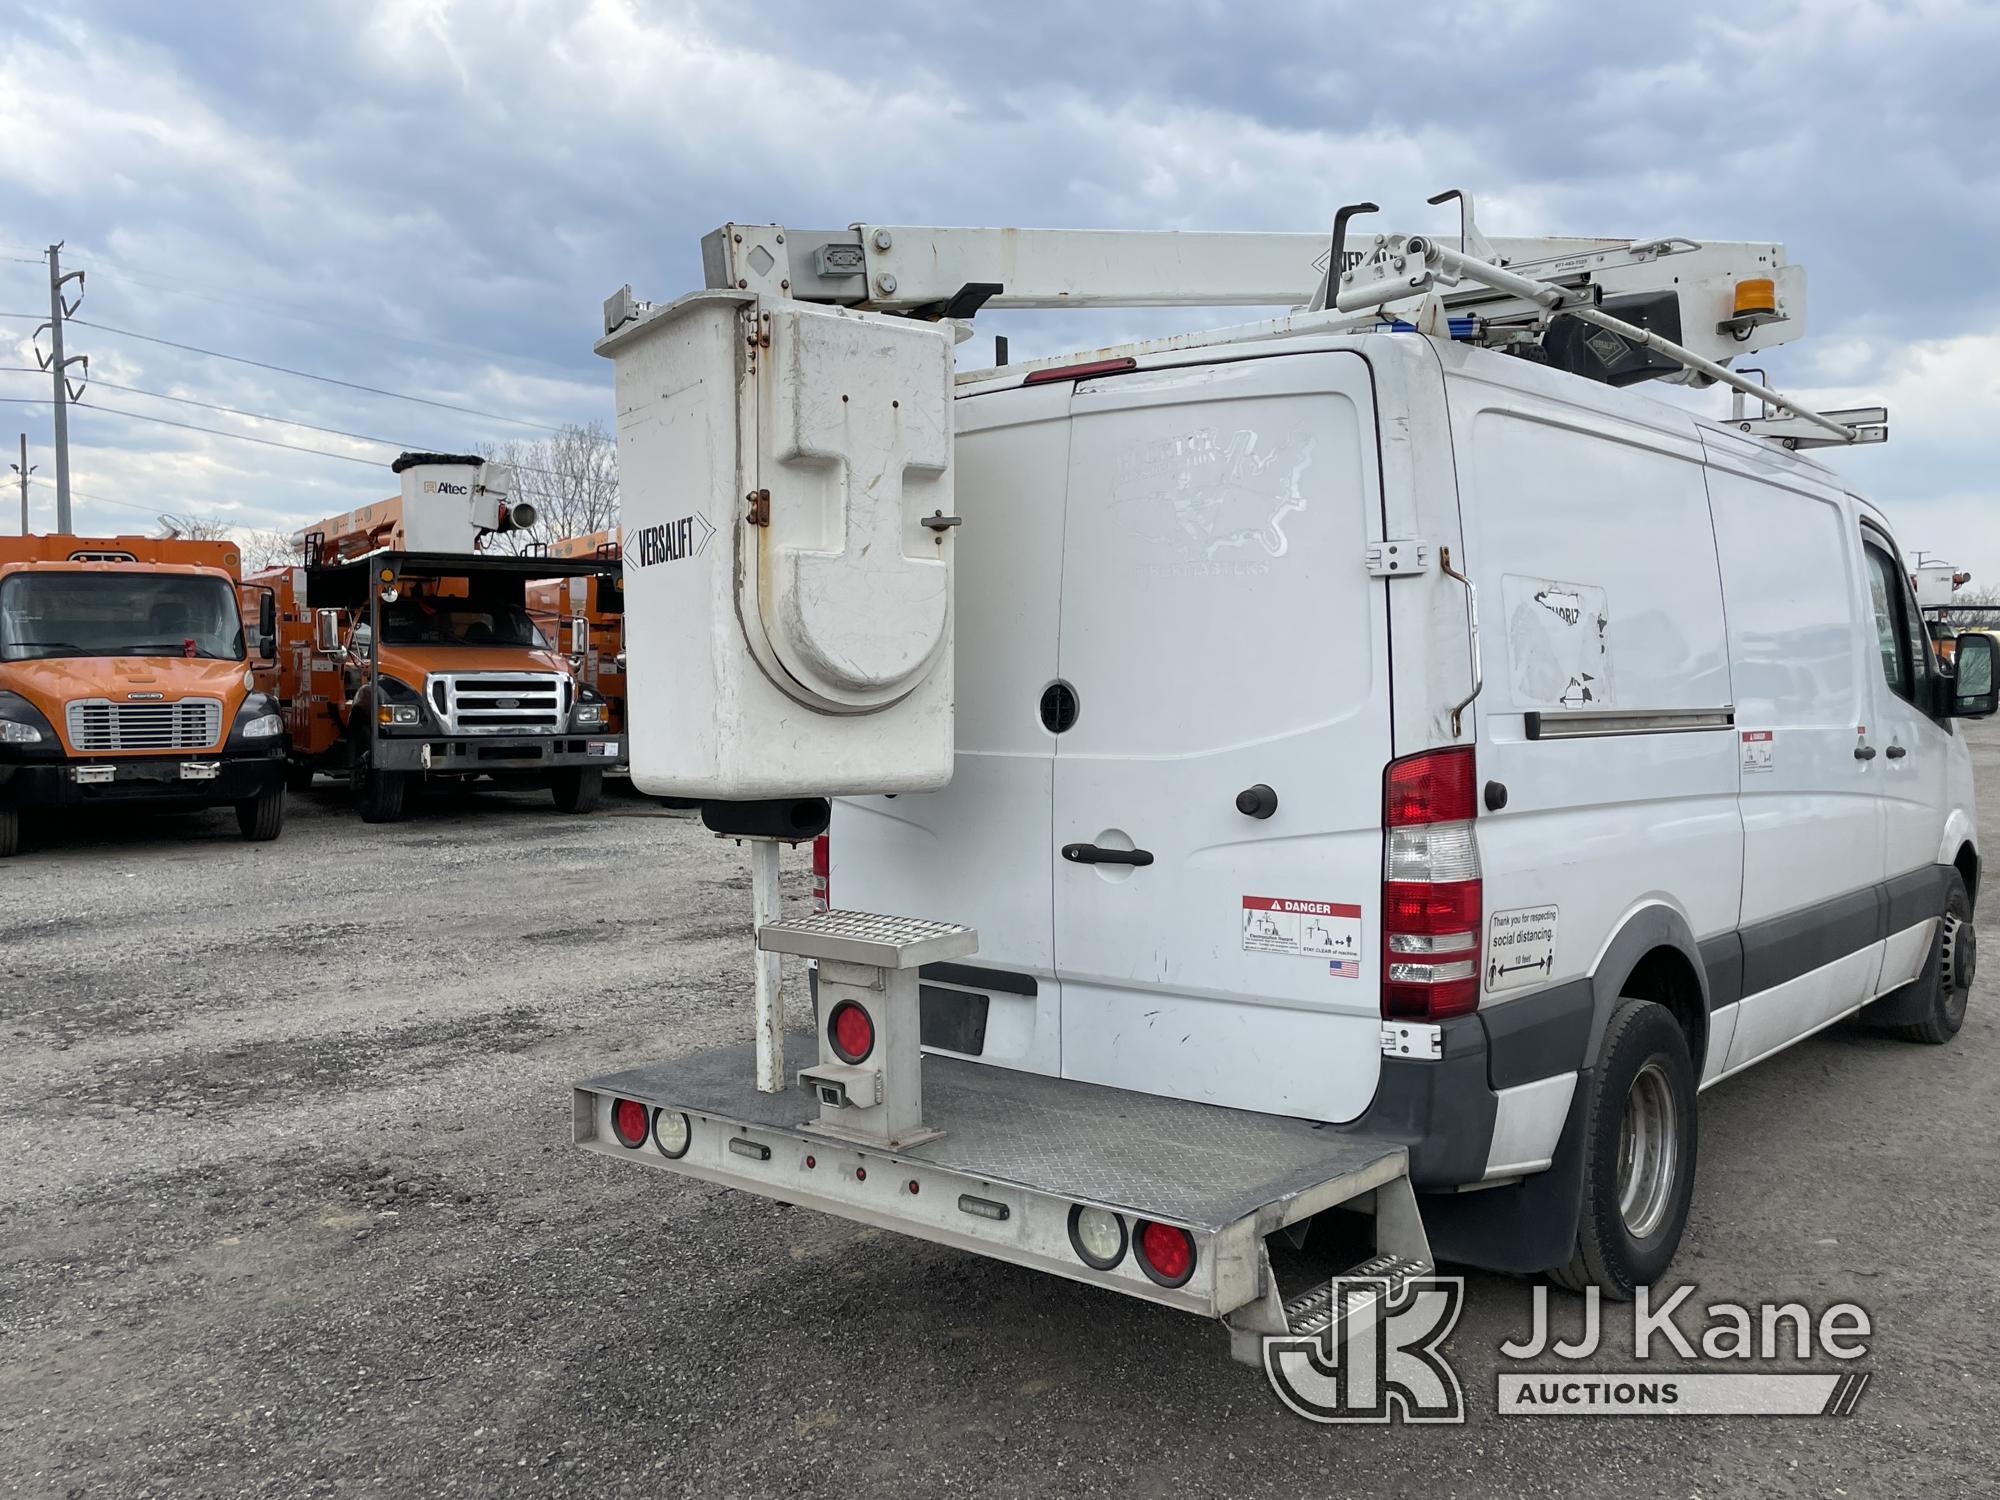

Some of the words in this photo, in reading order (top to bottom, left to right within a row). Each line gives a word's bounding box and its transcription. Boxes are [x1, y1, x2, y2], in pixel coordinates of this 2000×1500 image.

[437, 482, 467, 495] Altec
[639, 516, 693, 567] VERSALIFT
[1285, 901, 1331, 914] DANGER
[1494, 916, 1510, 926] Thank
[1511, 917, 1521, 927] you
[1521, 913, 1530, 923] for
[1530, 911, 1556, 923] respecting
[1494, 932, 1515, 947] social
